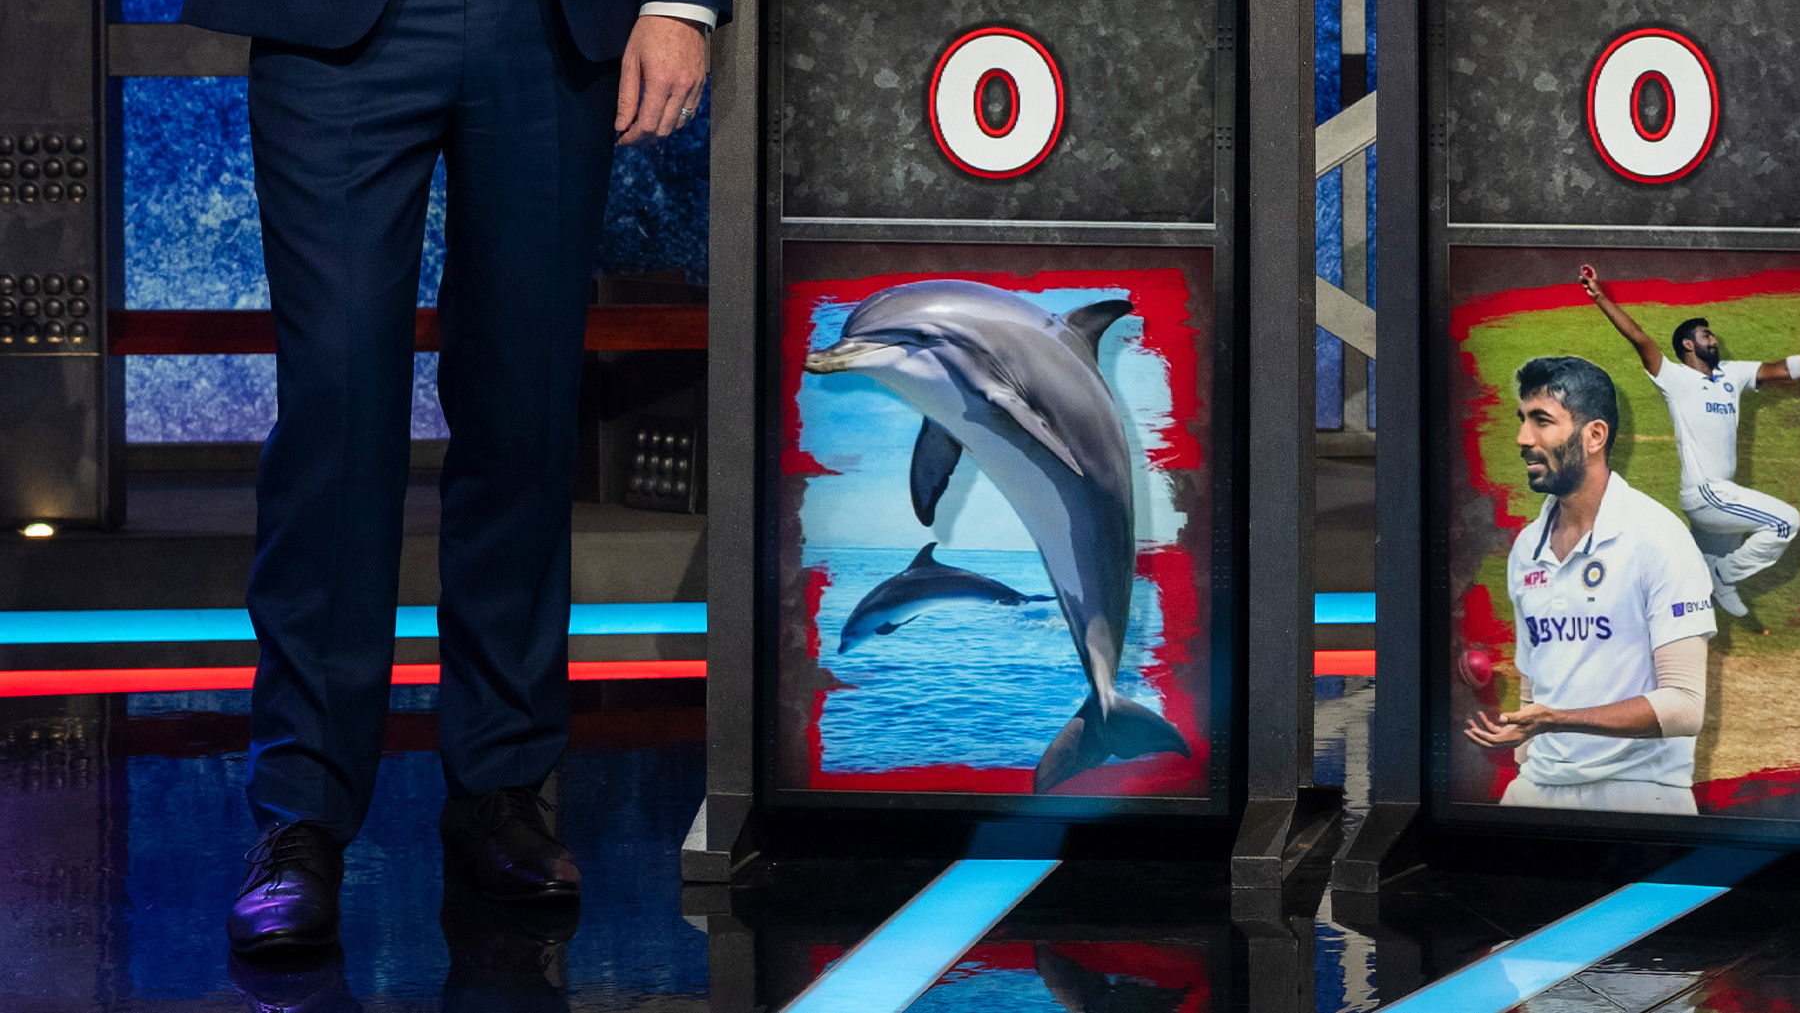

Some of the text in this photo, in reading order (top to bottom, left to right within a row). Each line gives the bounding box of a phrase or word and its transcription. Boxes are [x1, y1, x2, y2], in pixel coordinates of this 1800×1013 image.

[932, 31, 1061, 176] 0
[1590, 32, 1716, 180] 0
[1541, 615, 1613, 643] BYJU'S
